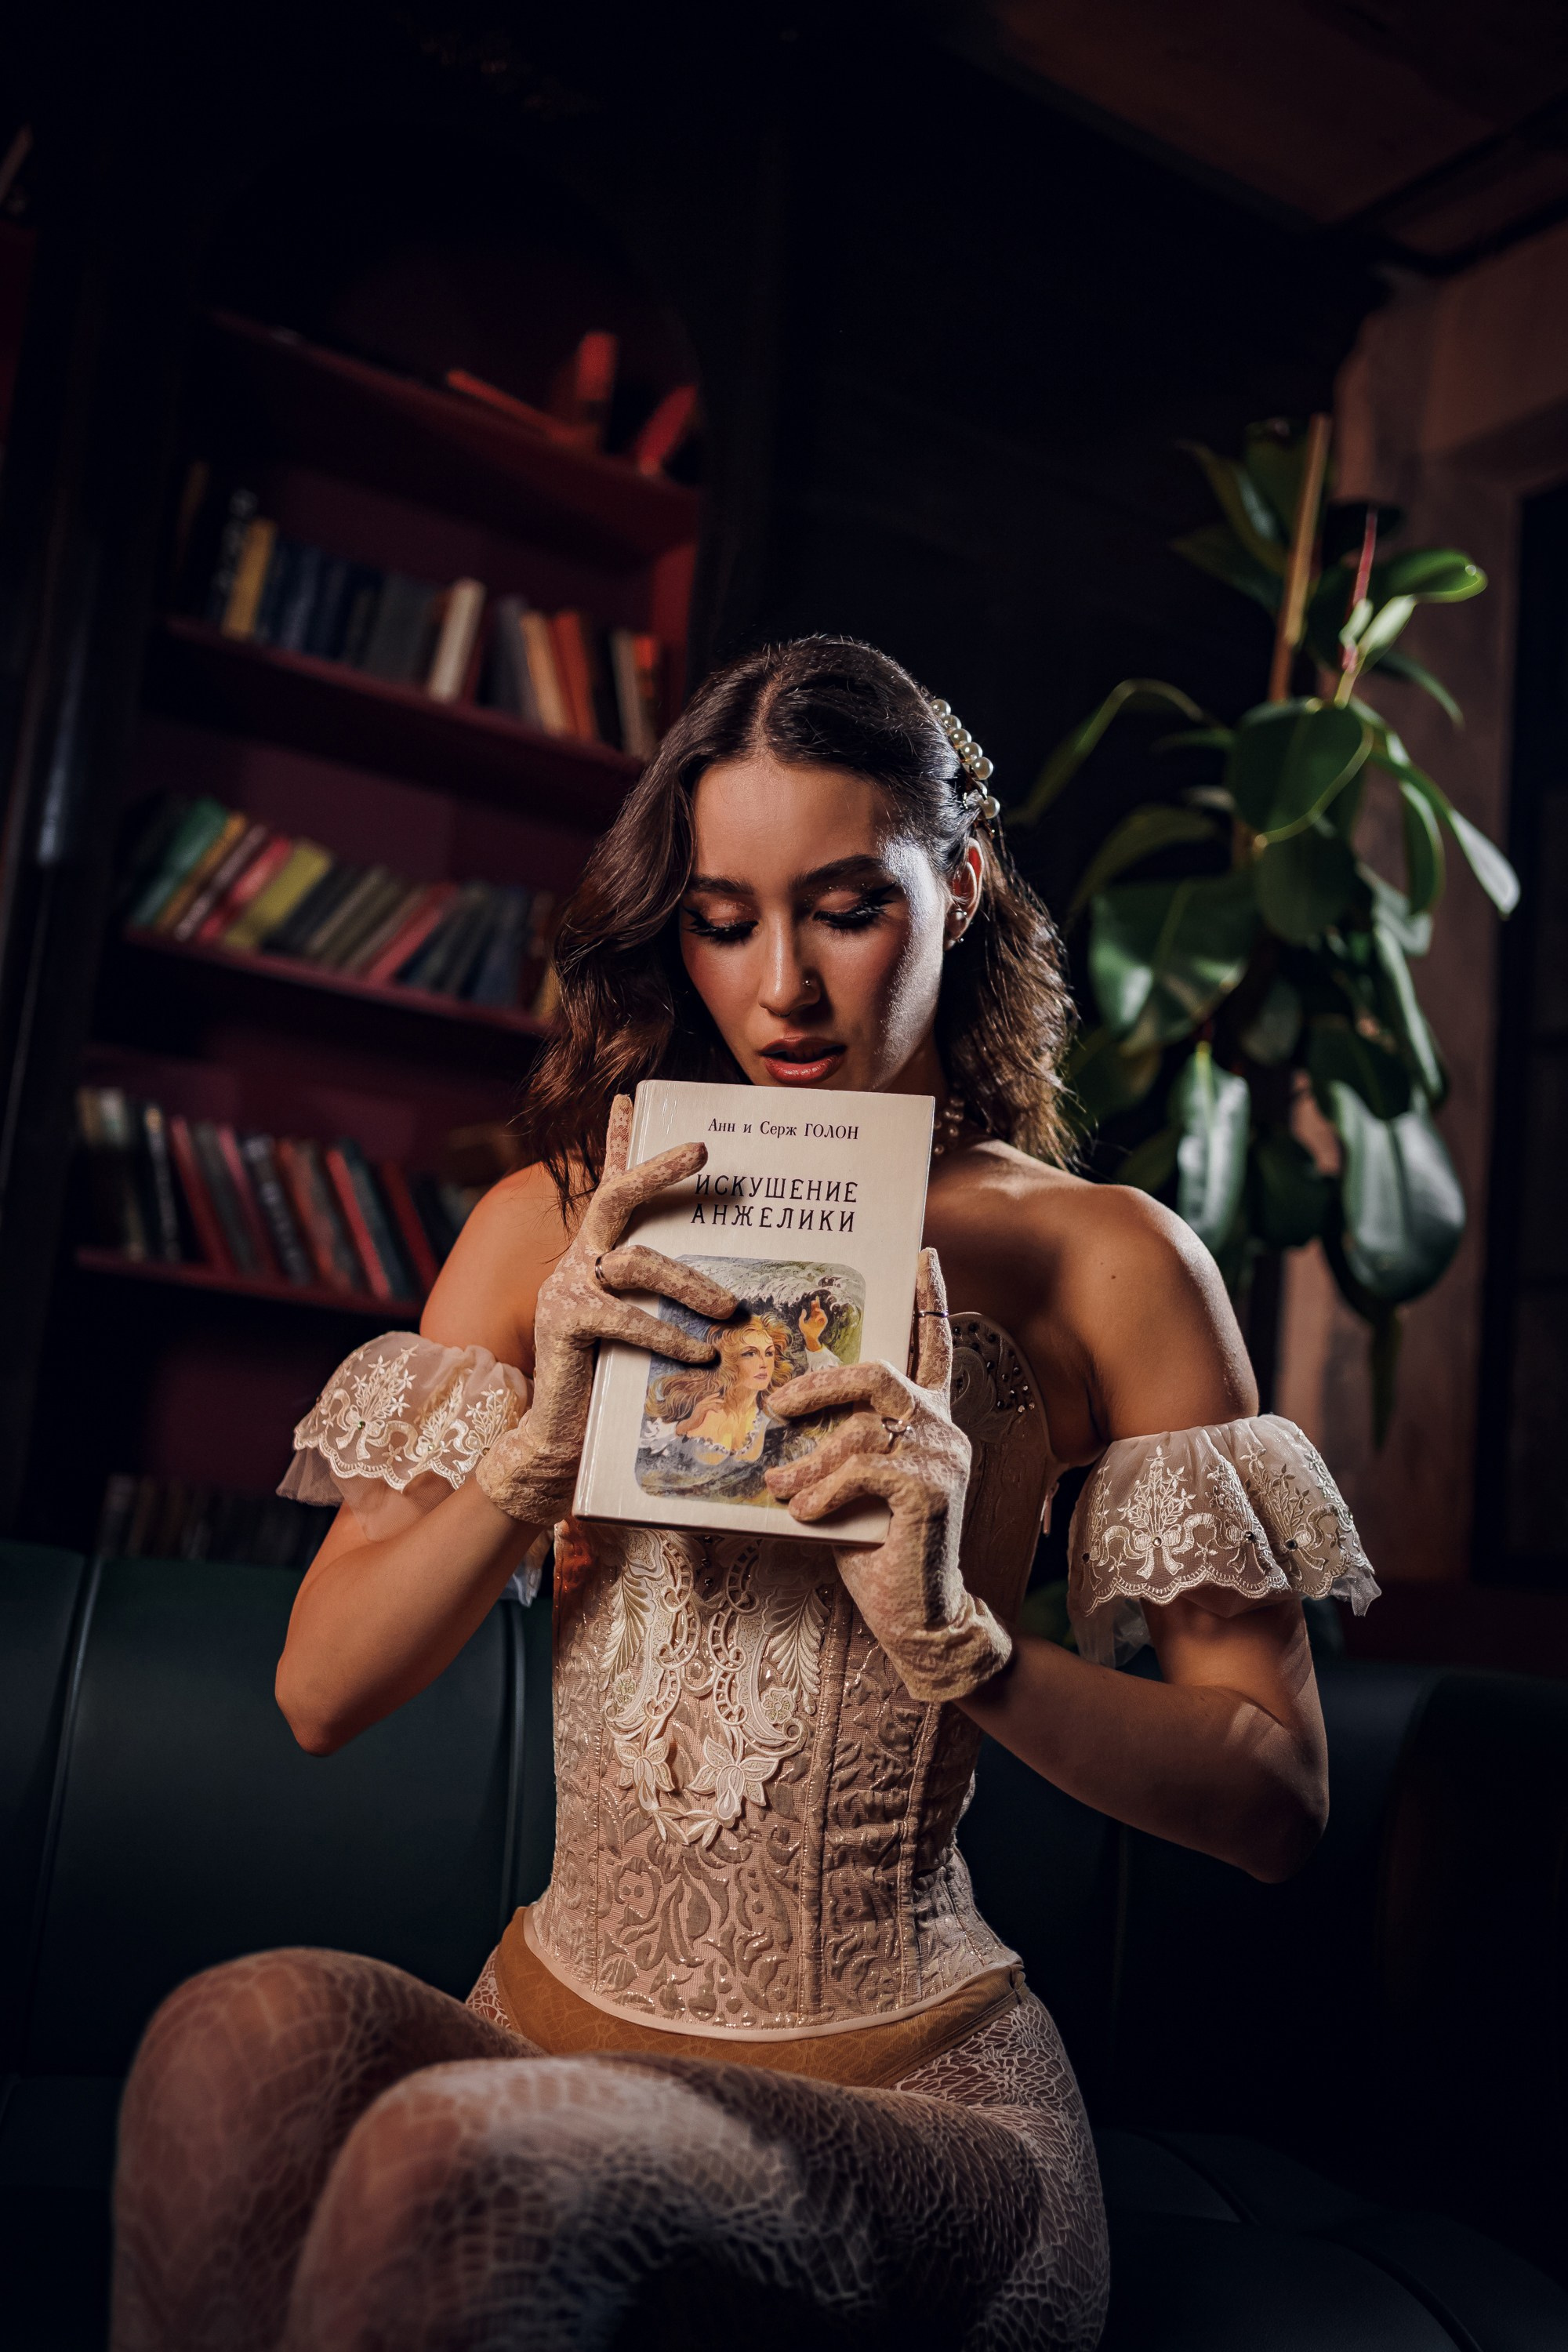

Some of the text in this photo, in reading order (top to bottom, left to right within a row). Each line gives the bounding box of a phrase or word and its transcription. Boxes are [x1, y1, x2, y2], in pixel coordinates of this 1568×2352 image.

[707, 1118, 859, 1140] Анн и Серж ГОЛОН
[695, 1174, 858, 1203] ИСКУШЕНИЕ
[691, 1203, 855, 1232] АНЖЕЛИКИ
